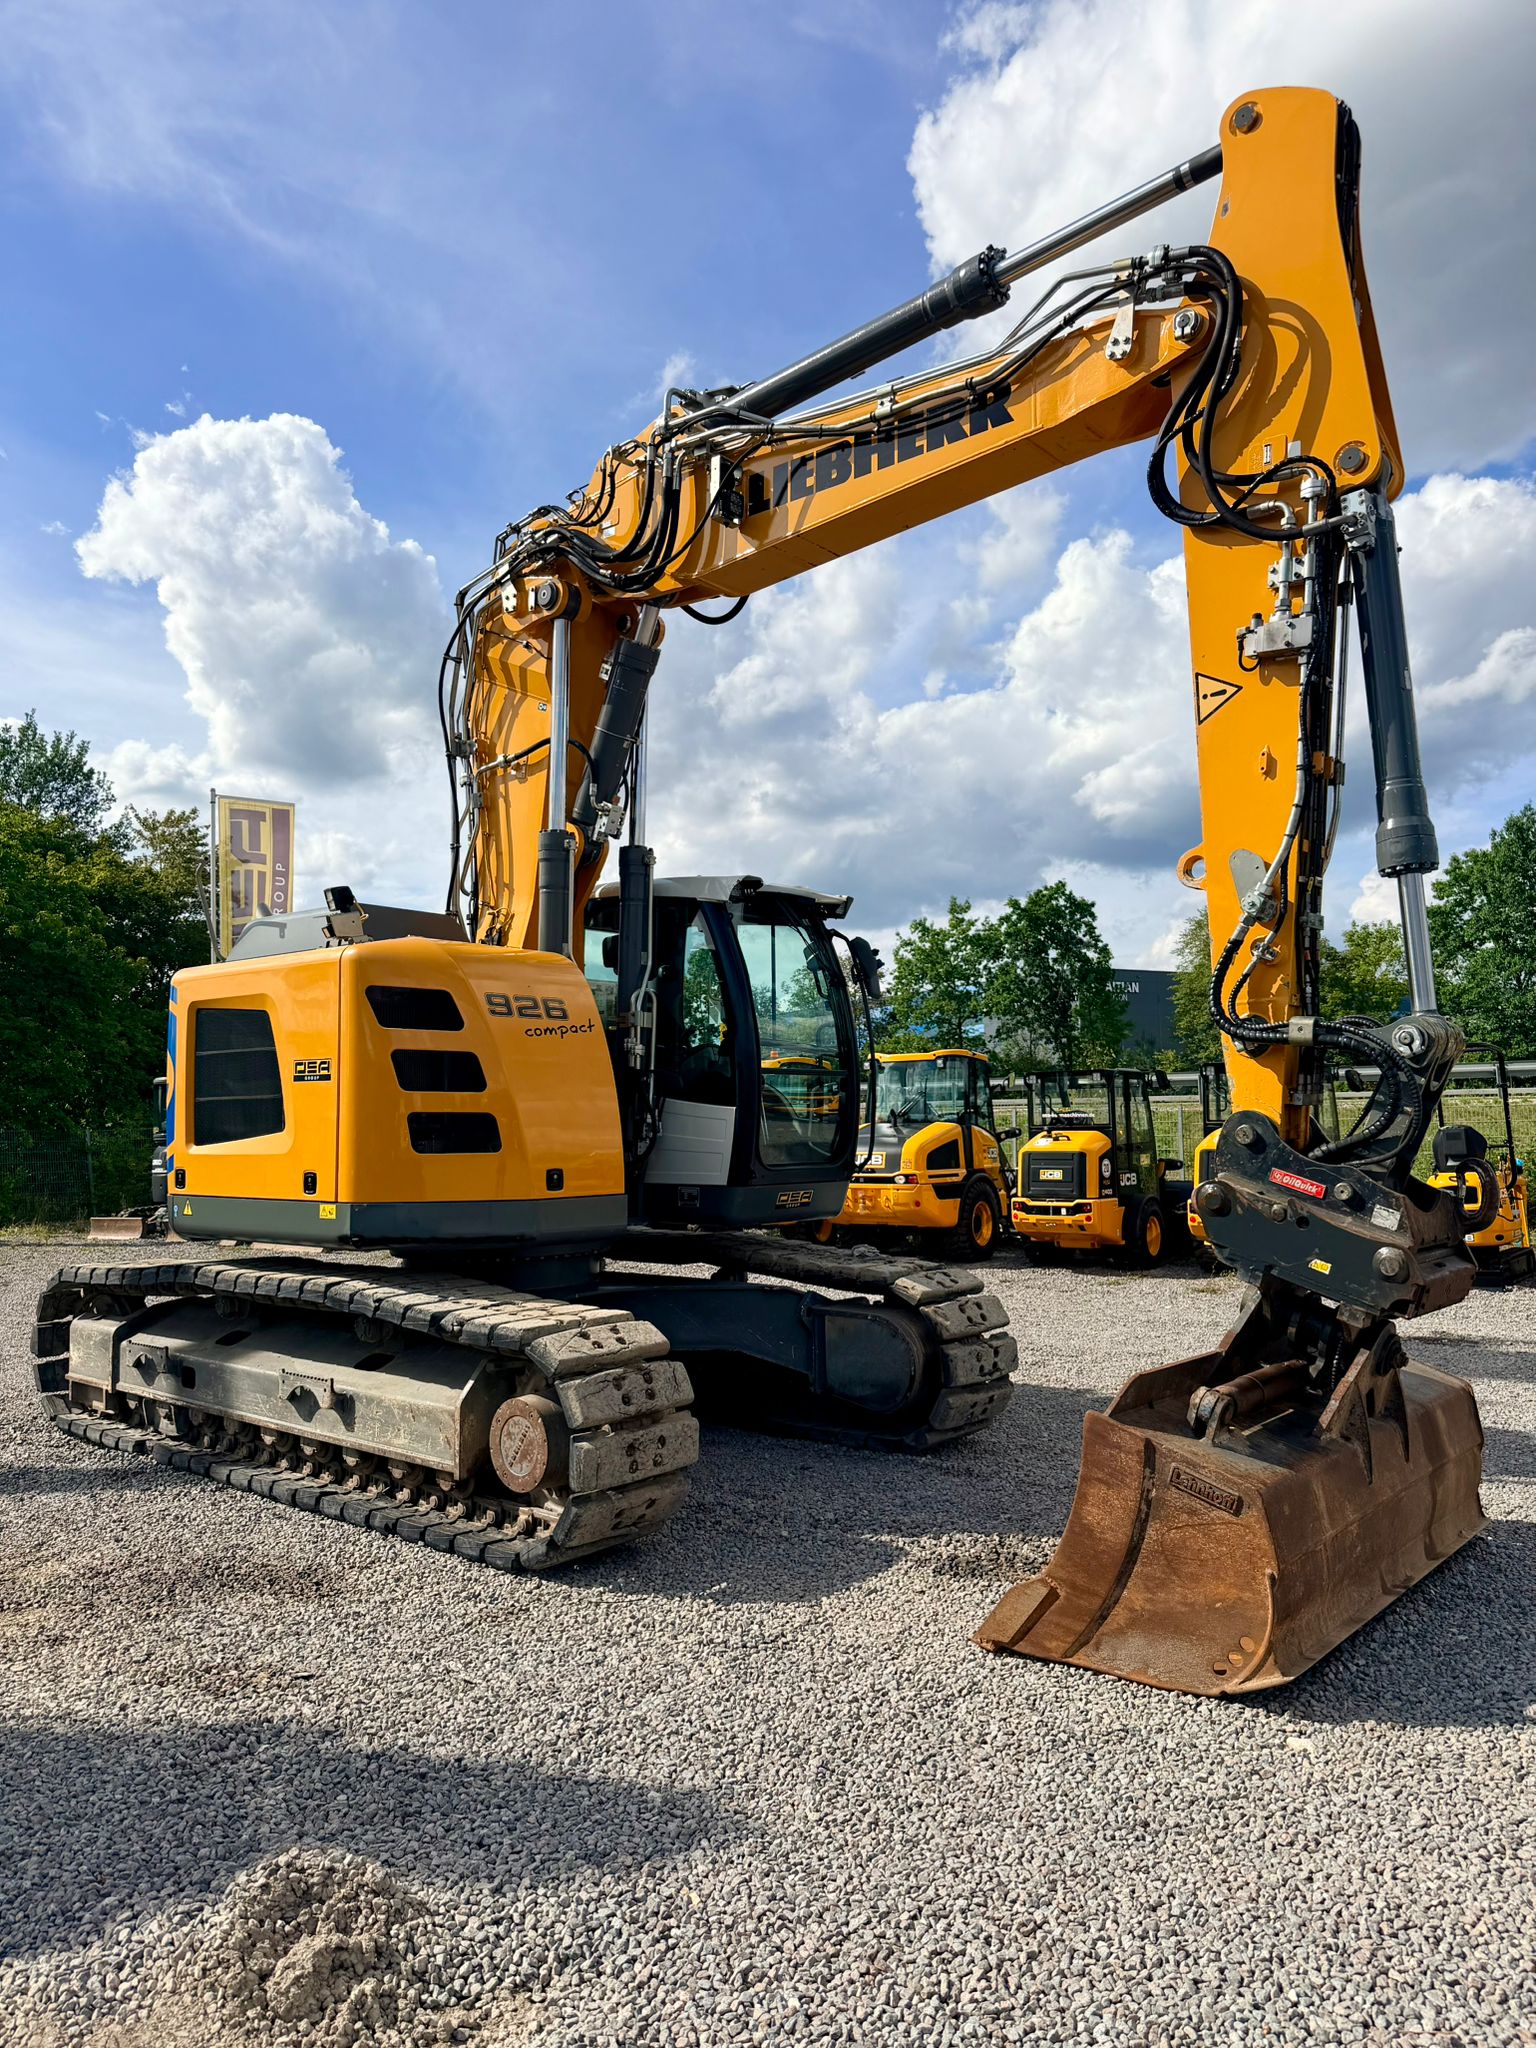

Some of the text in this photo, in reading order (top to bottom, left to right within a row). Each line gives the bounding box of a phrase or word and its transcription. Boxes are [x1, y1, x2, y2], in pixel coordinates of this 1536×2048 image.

[748, 384, 1014, 516] LIEBHERR
[273, 862, 286, 915] ROUP
[485, 992, 569, 1020] 926
[524, 1018, 596, 1039] compact
[1120, 1173, 1137, 1186] JCB
[1282, 1175, 1319, 1193] OilQuick
